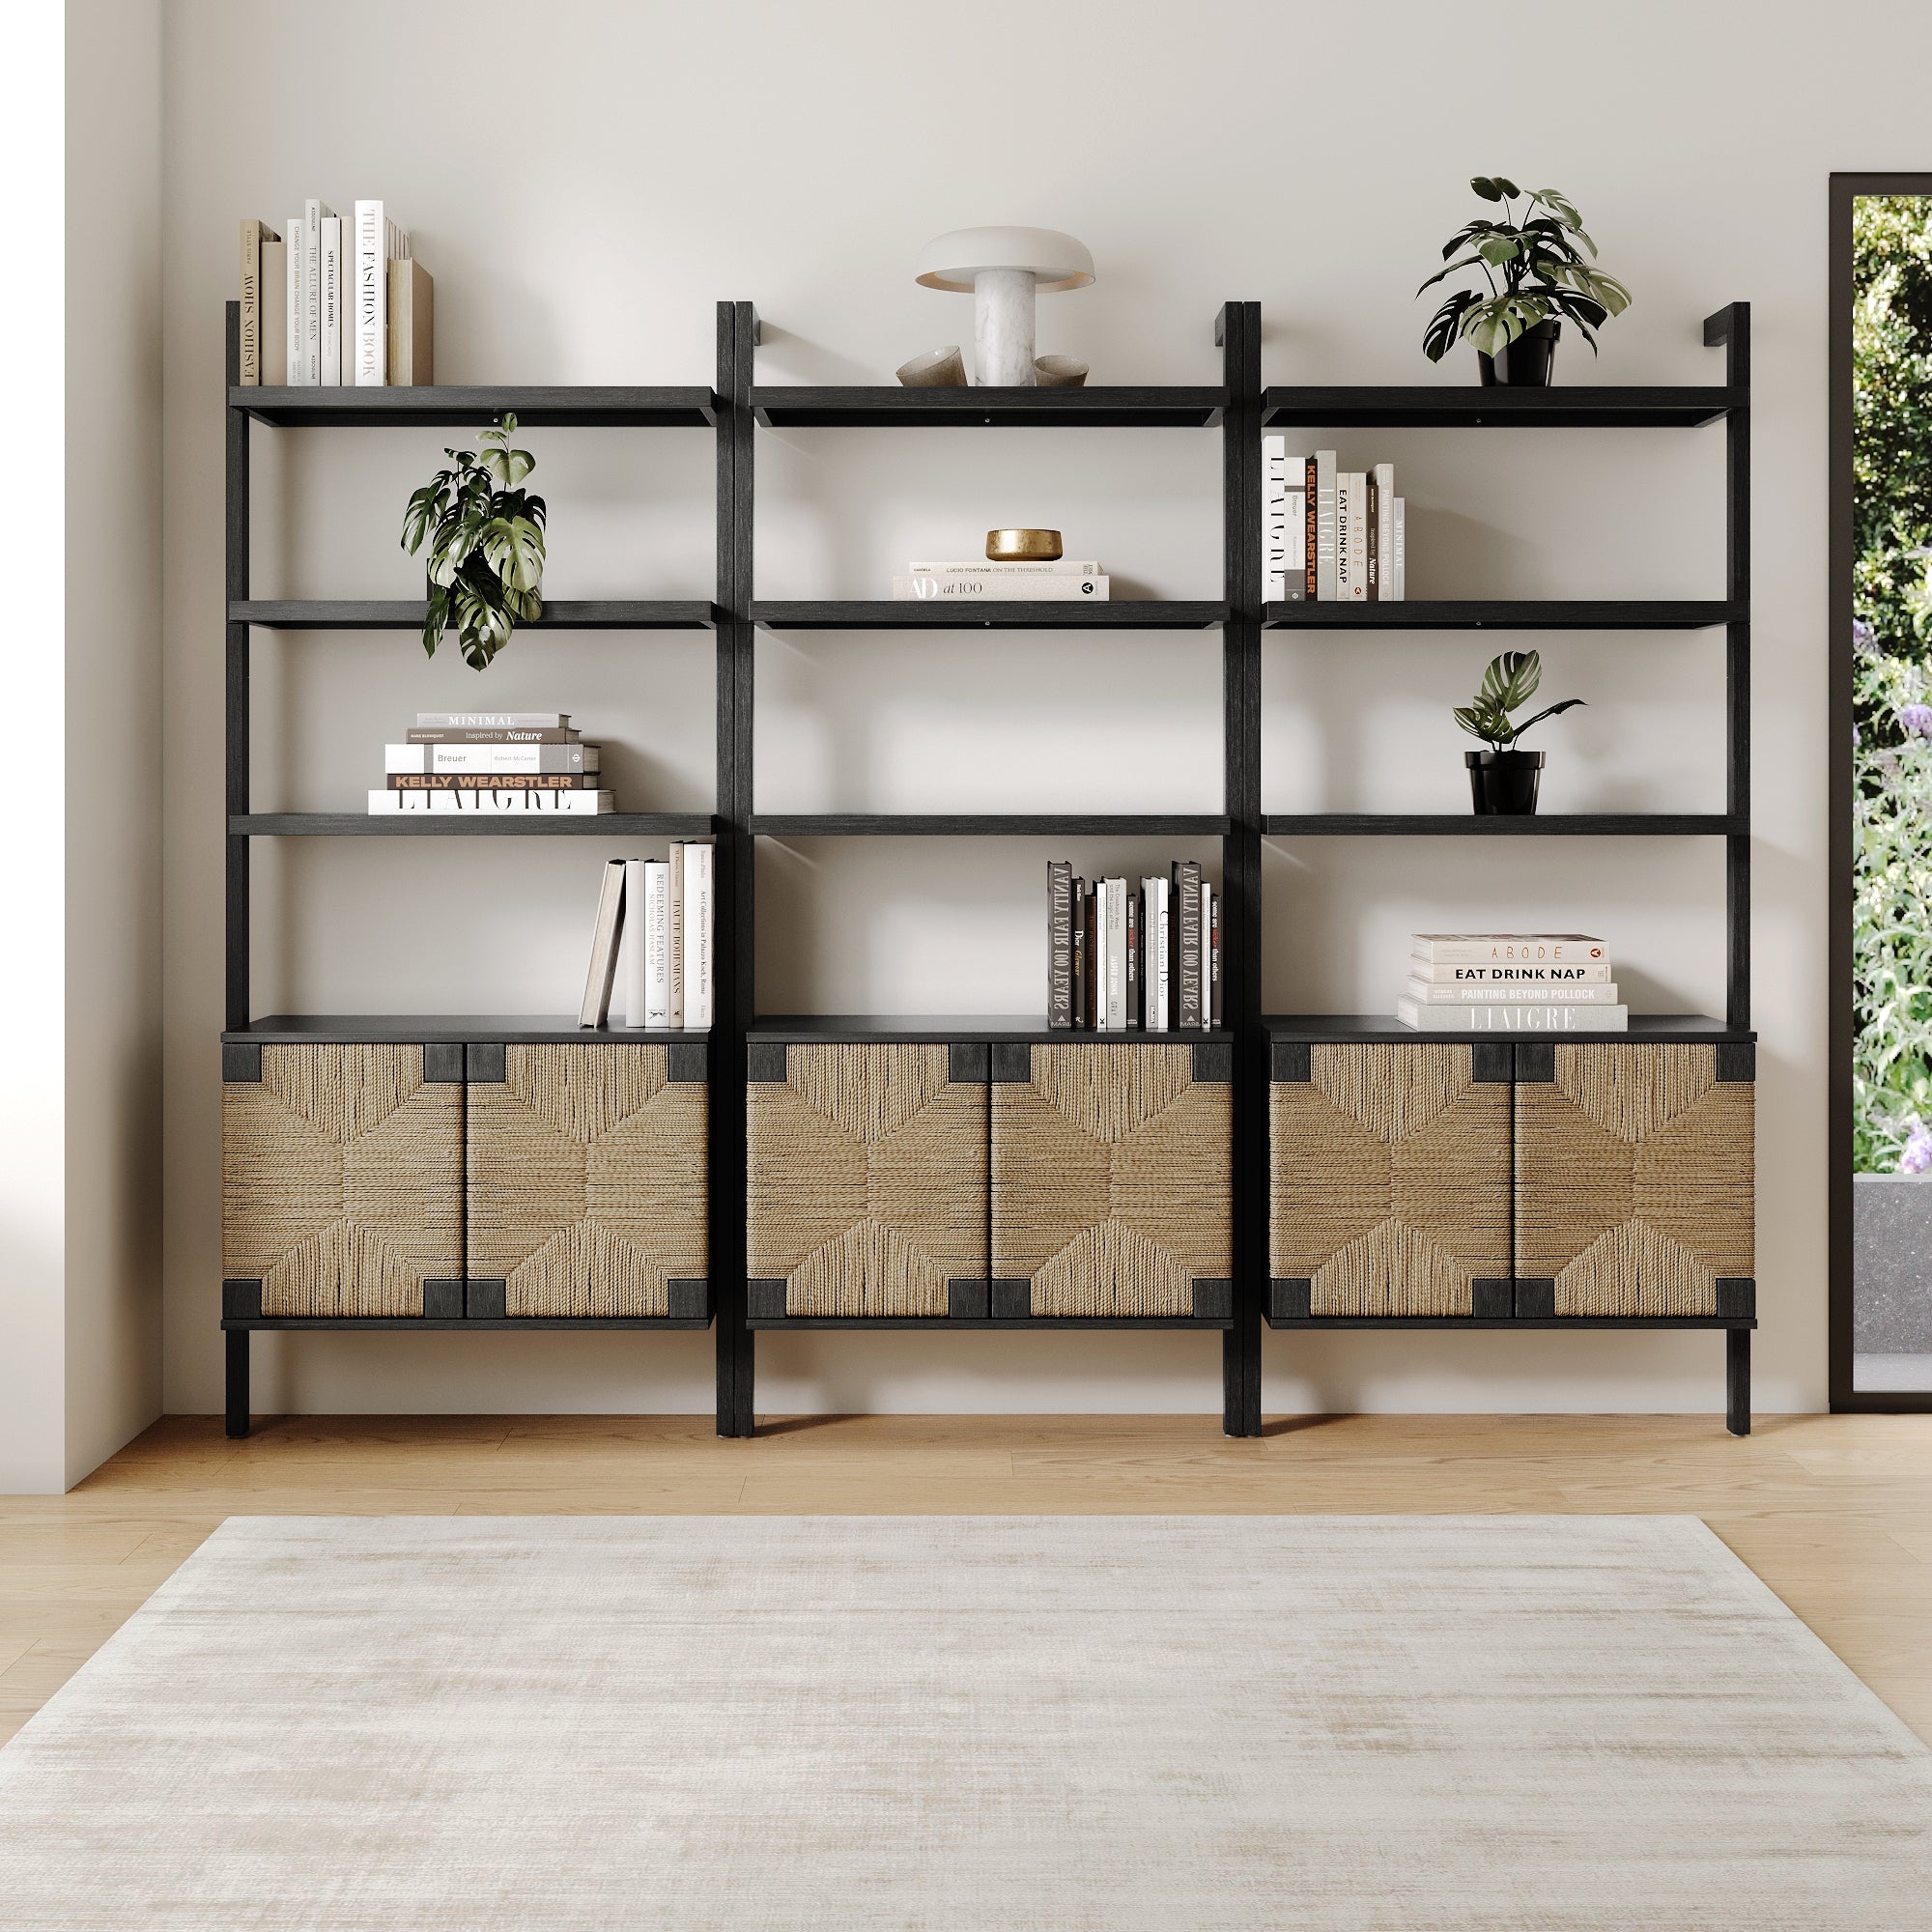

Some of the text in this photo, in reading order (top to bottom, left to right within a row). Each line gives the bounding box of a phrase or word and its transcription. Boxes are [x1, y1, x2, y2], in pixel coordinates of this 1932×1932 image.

[362, 210, 376, 378] THE FASHION BOOK
[309, 304, 317, 317] OF
[244, 273, 253, 378] FASHION SHOW
[1319, 488, 1334, 564] LIAIGRE
[910, 578, 982, 599] AD at 100
[448, 716, 515, 725] MINIMAL
[494, 731, 503, 740] by
[505, 731, 543, 741] Nature
[395, 777, 572, 787] KELLY WEARSTLER
[1074, 930, 1083, 946] Dior
[1159, 911, 1168, 999] Christian Dior
[1492, 947, 1563, 958] ABODE
[1455, 969, 1585, 980] EAT DRINK NAP
[1462, 989, 1595, 1000] PAINTING BEYOND POLLOCK
[1470, 1008, 1577, 1030] LIAIGRE
